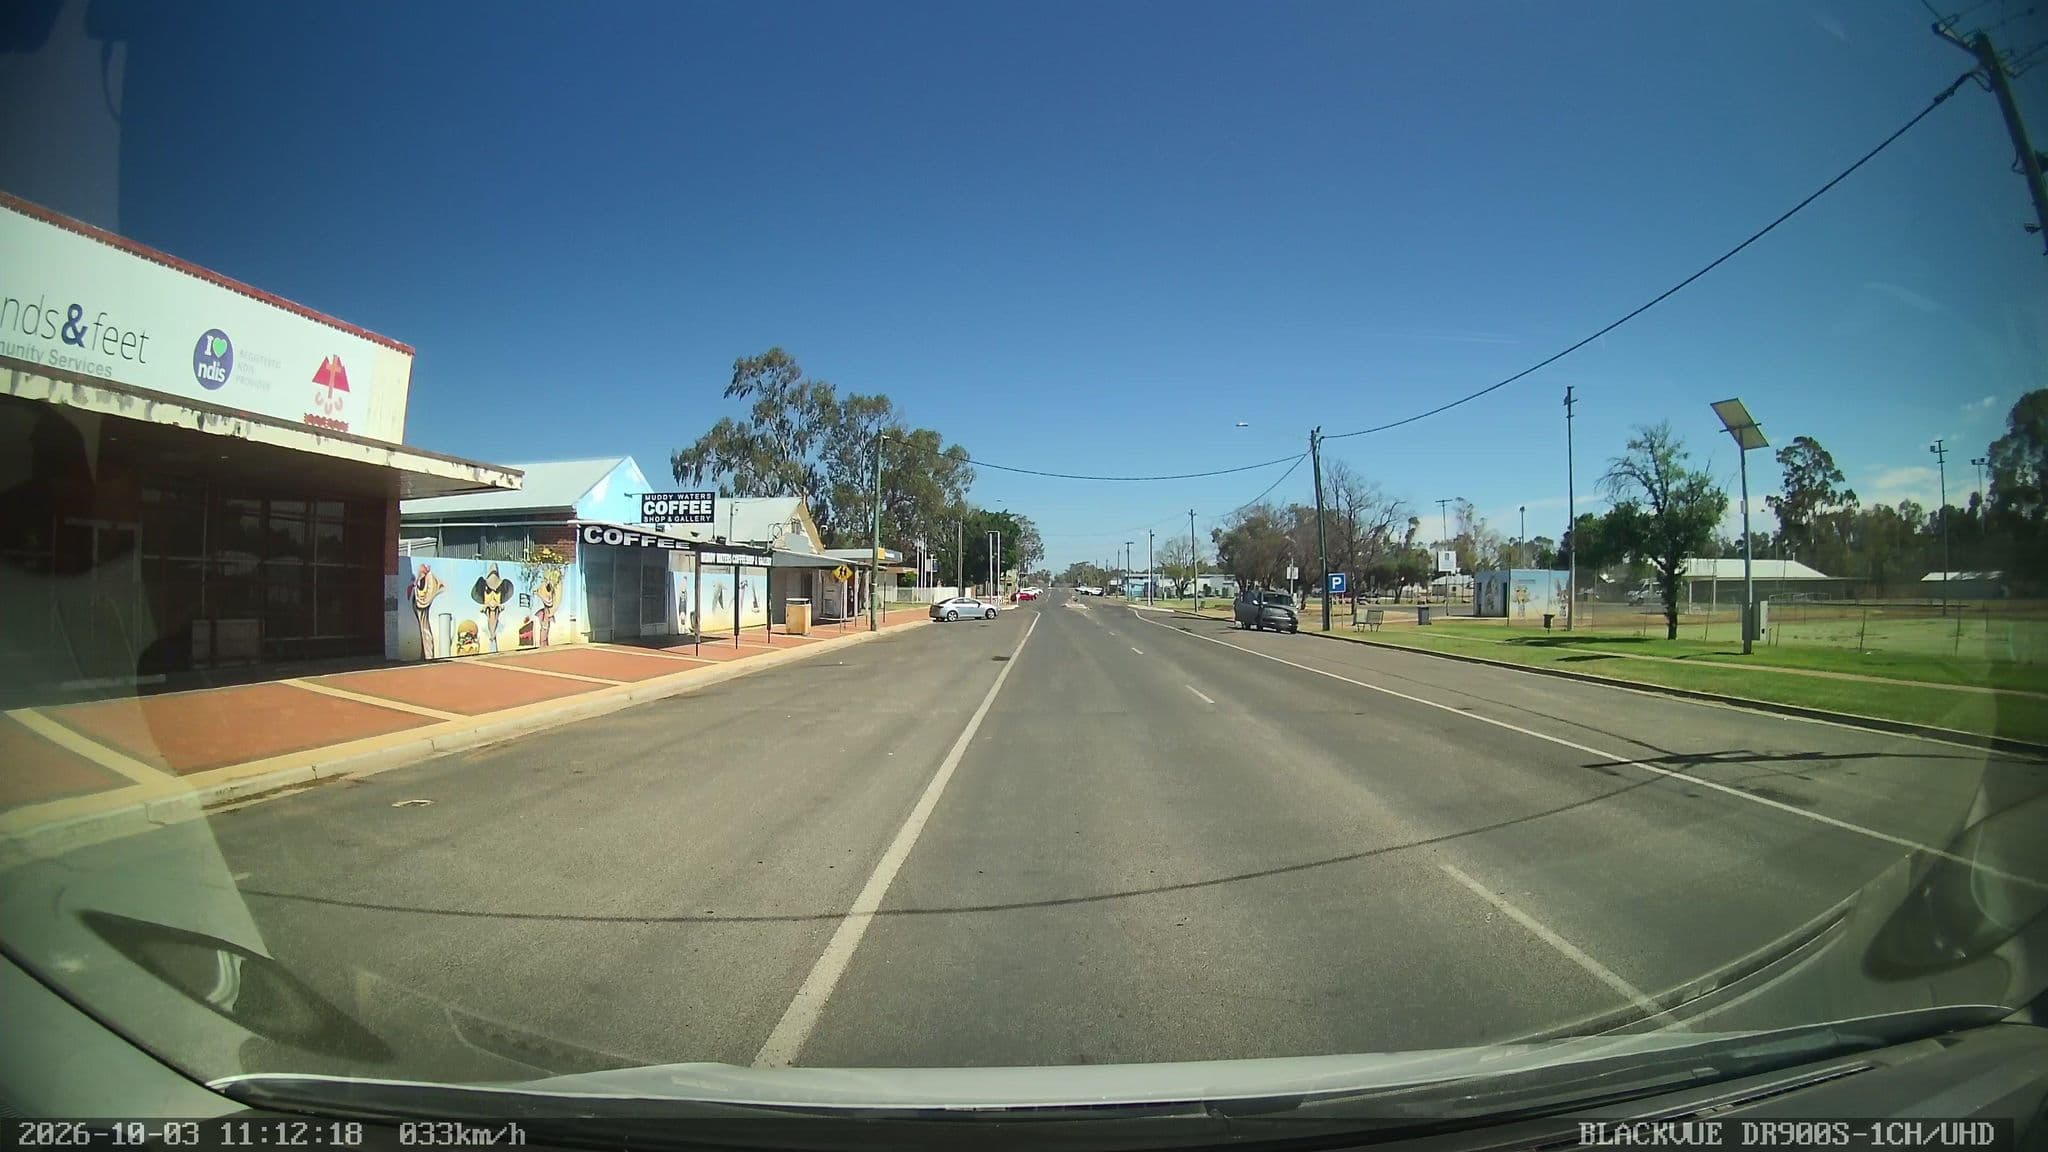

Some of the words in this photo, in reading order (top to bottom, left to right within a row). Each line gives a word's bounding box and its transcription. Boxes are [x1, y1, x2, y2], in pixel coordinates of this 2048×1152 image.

[205, 335, 214, 356] I
[48, 349, 113, 378] Services
[197, 361, 226, 383] ndis
[643, 500, 712, 515] COFFEE
[643, 515, 666, 523] SHOP
[583, 525, 691, 550] COFFEE
[1332, 577, 1342, 589] P
